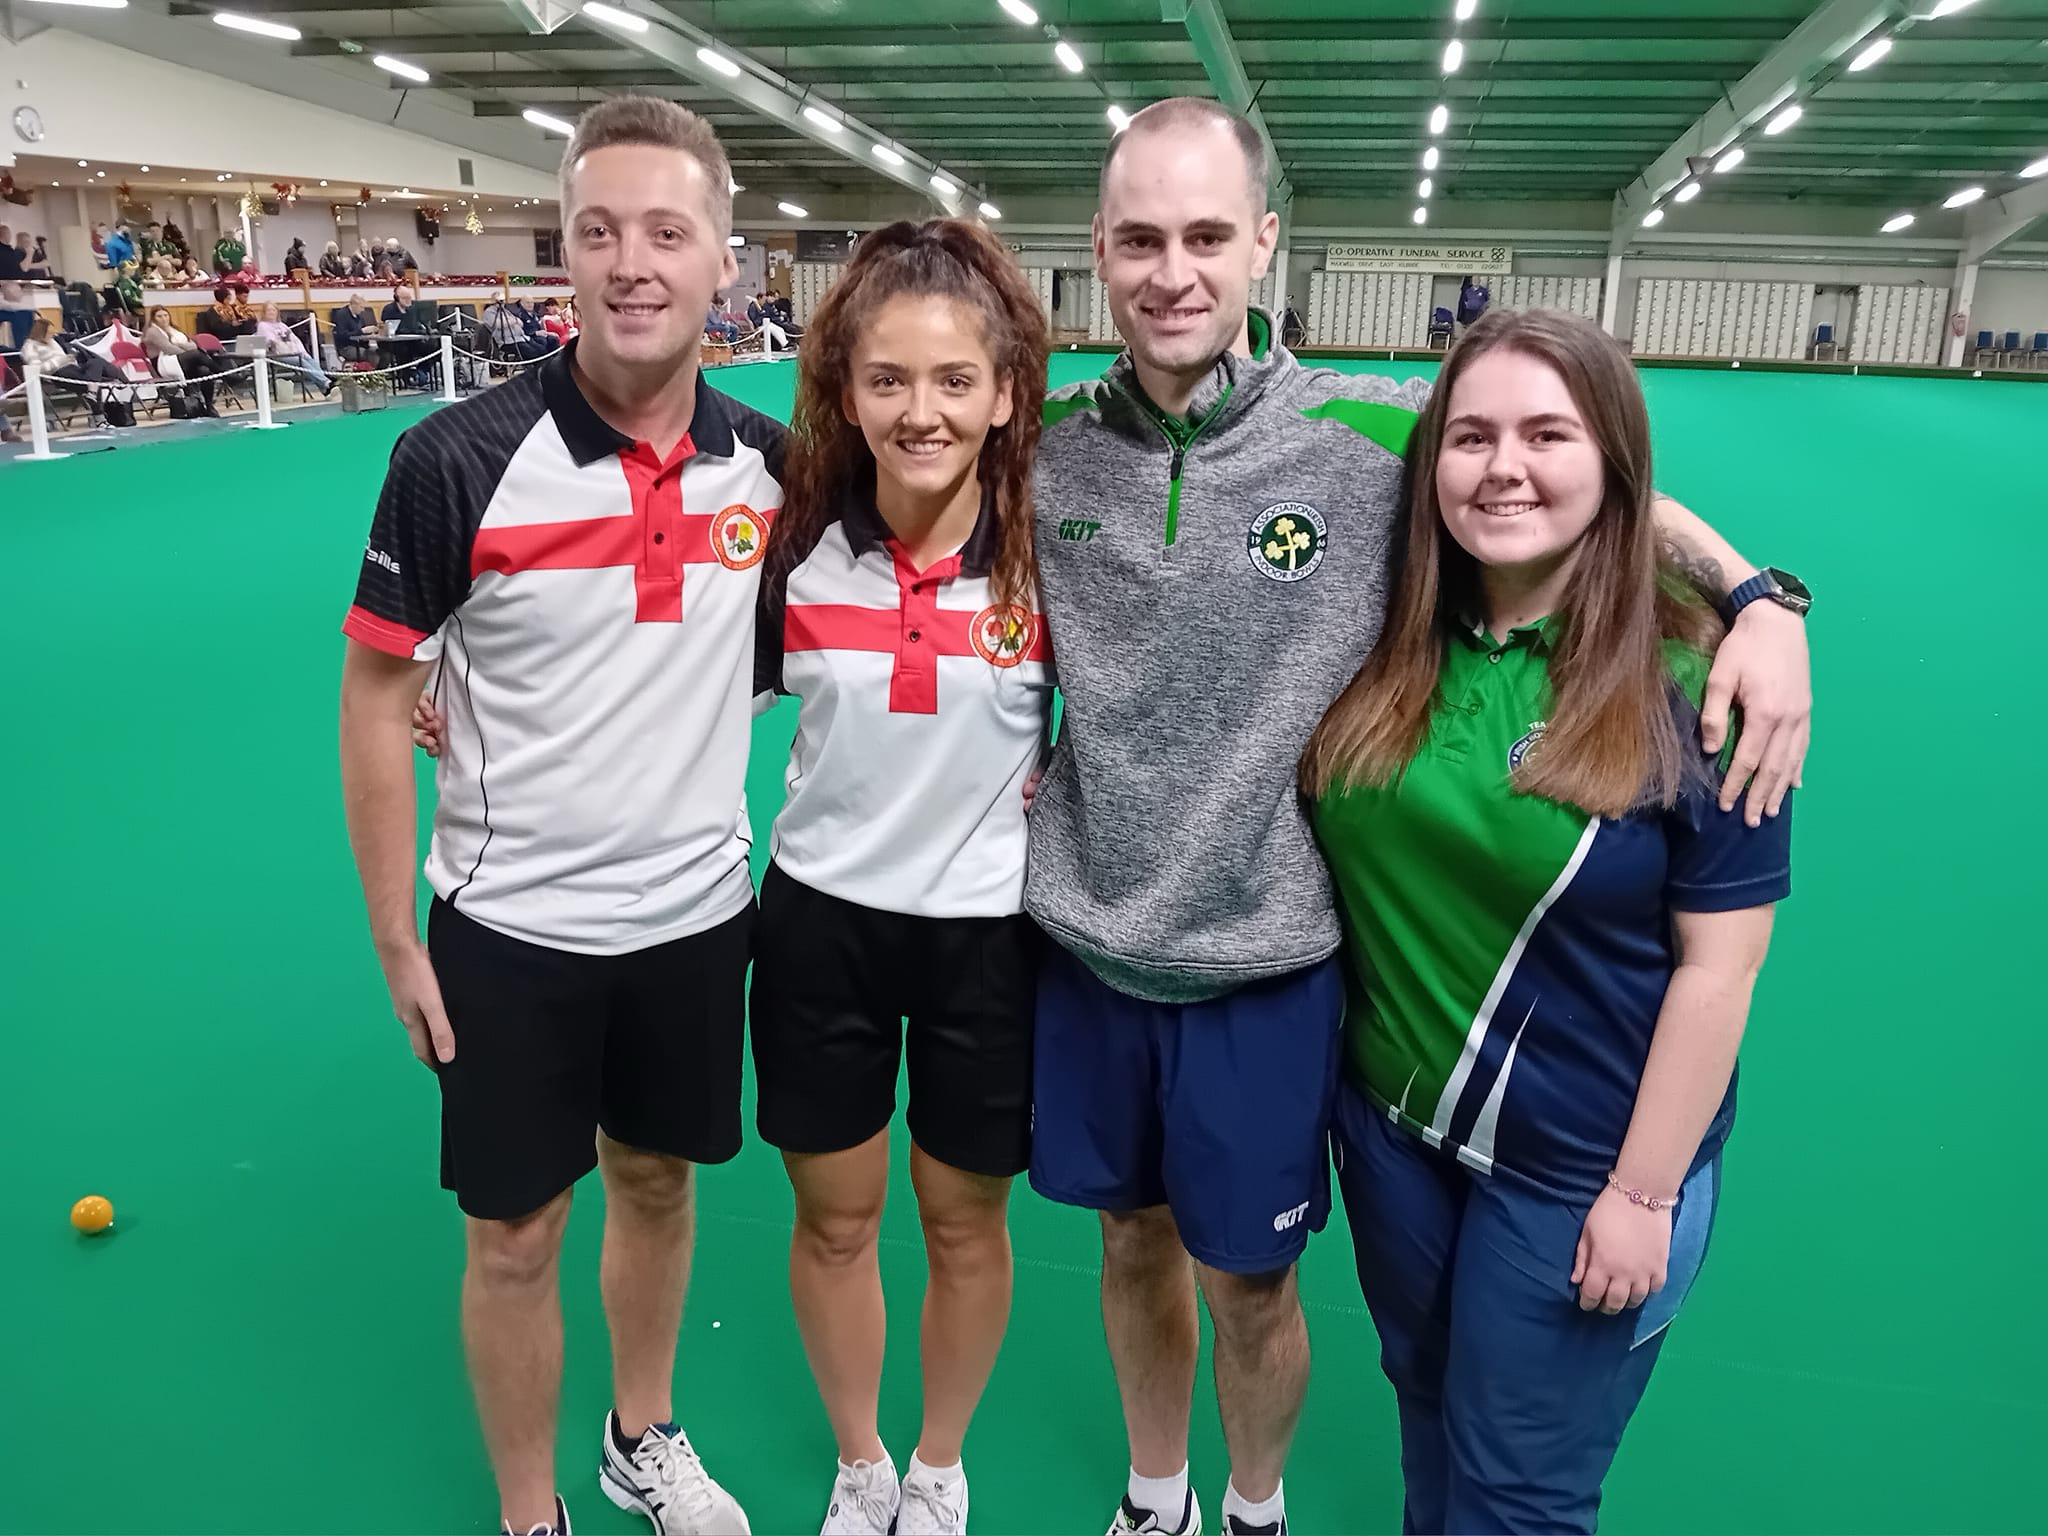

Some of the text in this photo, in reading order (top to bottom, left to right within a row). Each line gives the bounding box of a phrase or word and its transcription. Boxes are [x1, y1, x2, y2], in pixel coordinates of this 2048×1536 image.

[1400, 249, 1440, 257] FUNERAL
[1447, 250, 1485, 259] SERVICE
[1254, 555, 1320, 580] INDOOR BOWLS
